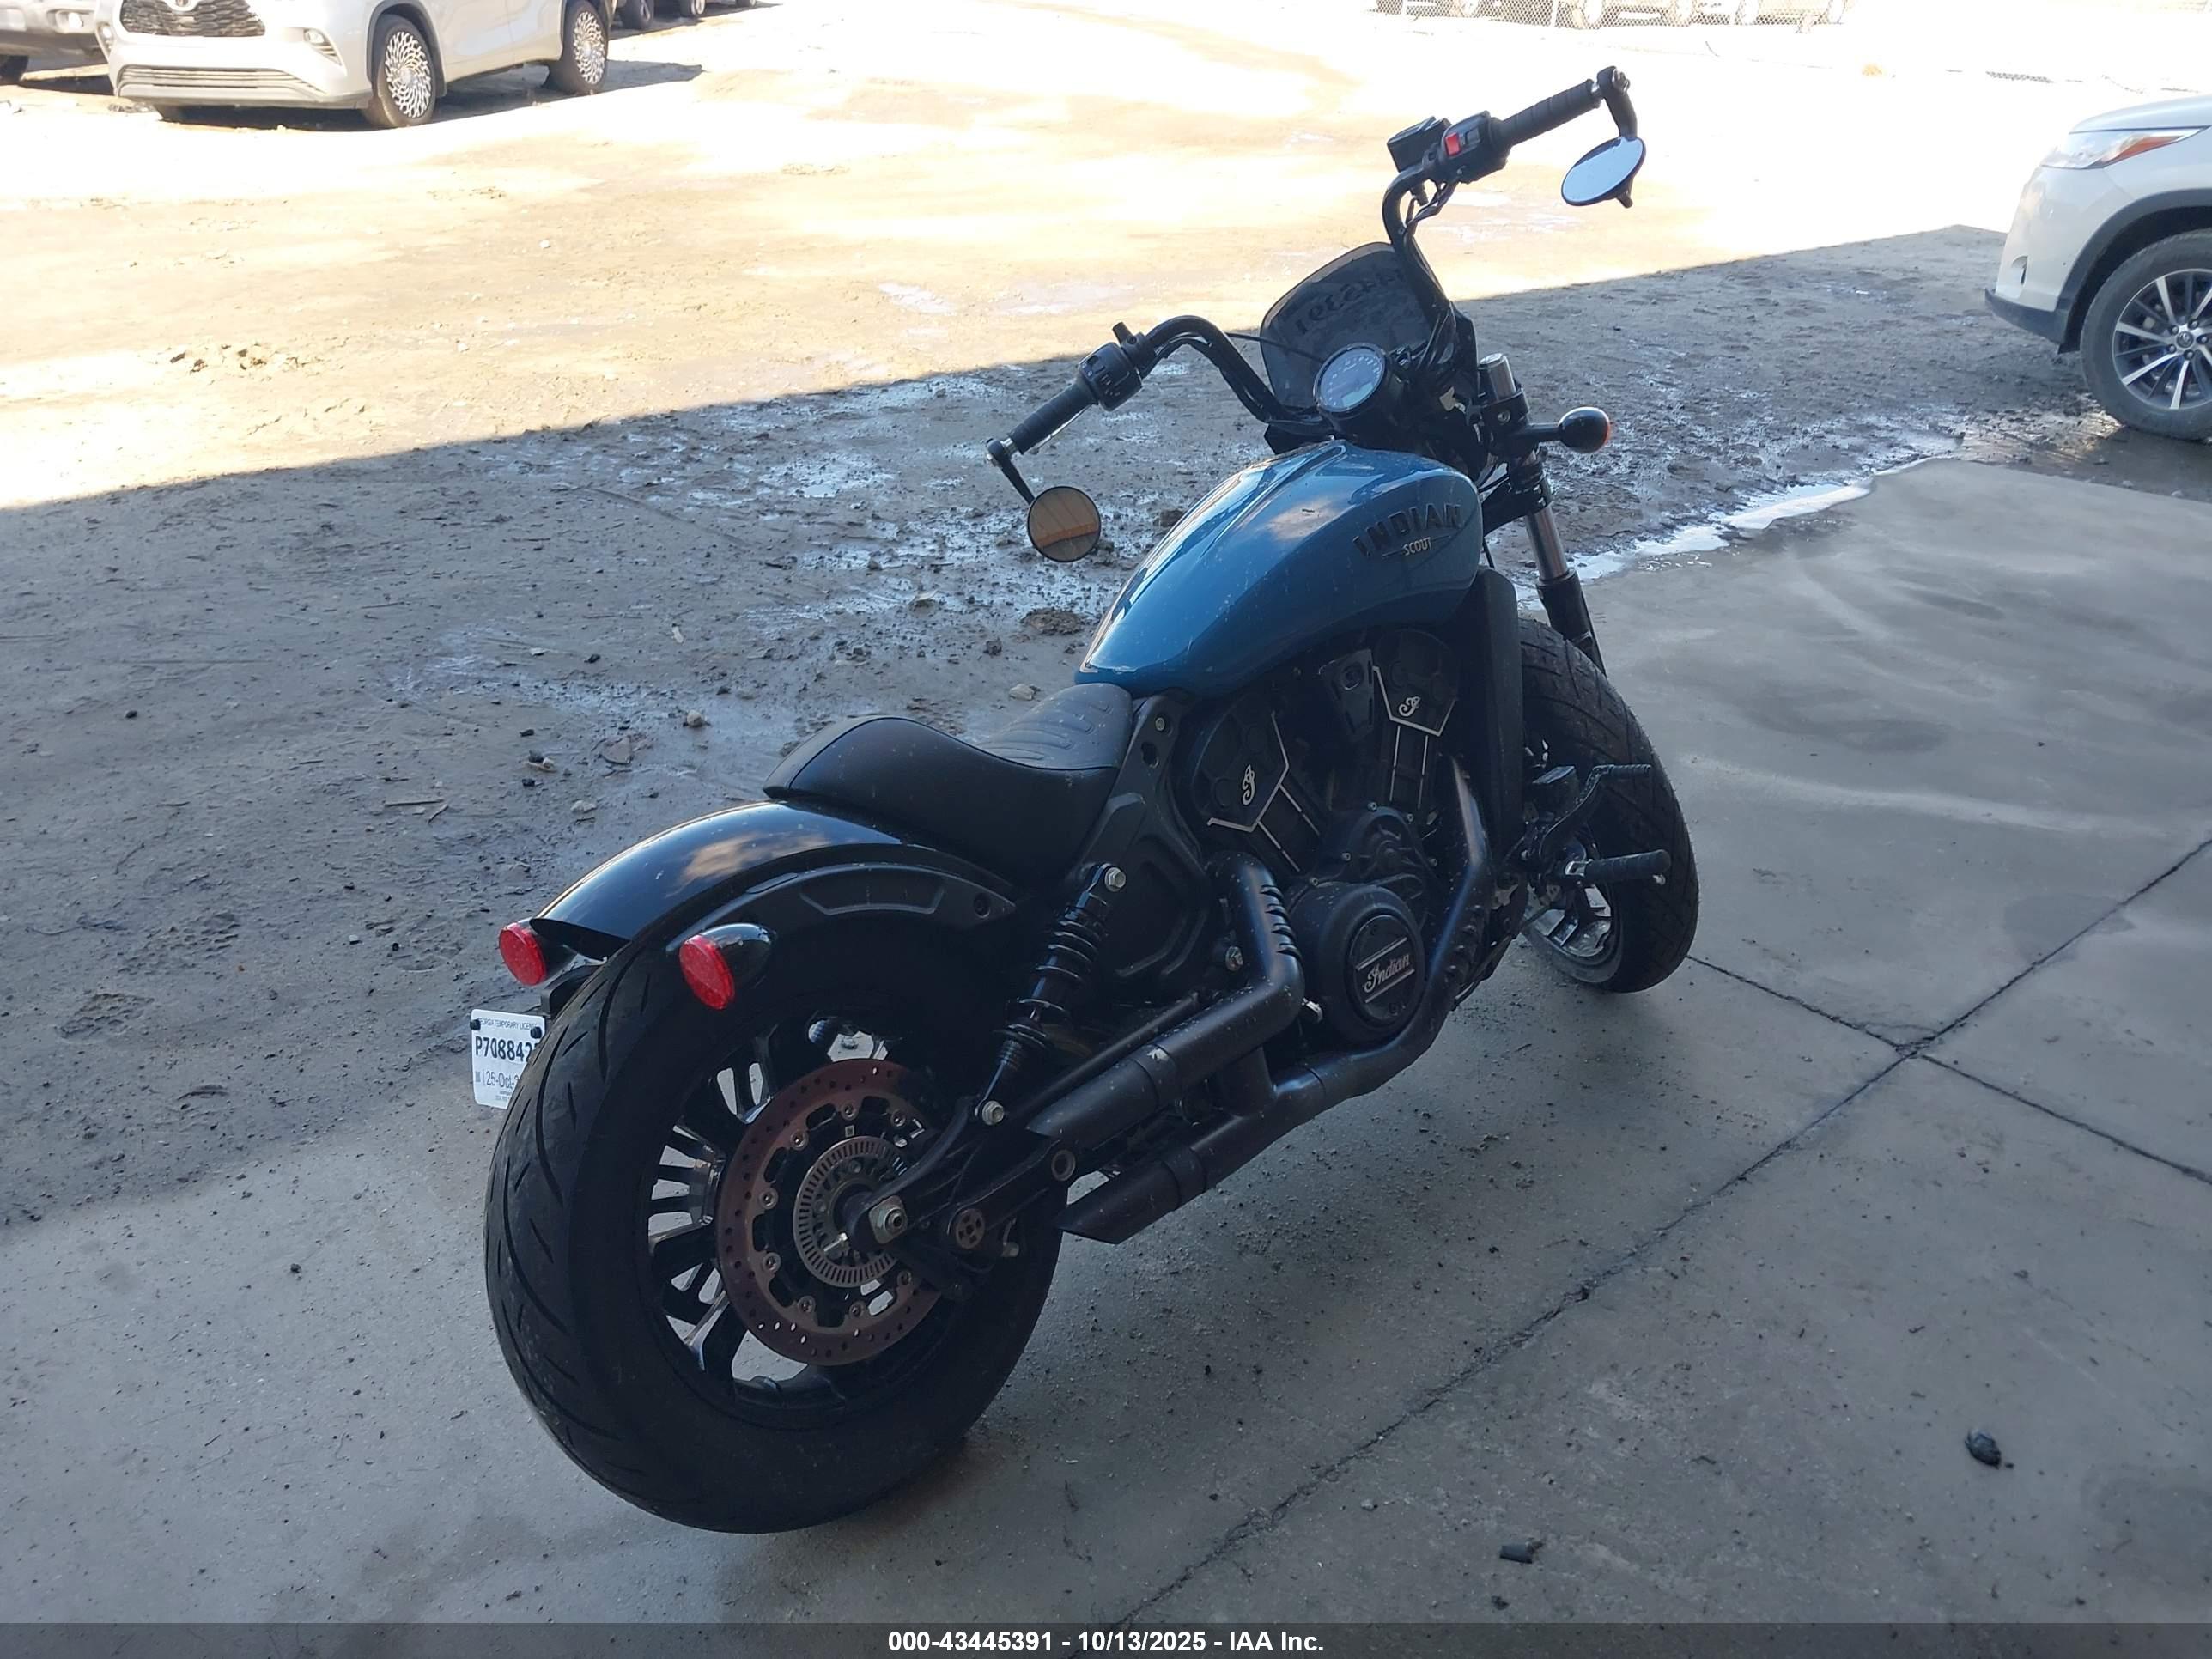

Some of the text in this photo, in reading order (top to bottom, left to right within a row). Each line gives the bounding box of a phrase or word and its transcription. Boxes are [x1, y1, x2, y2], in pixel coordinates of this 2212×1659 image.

[1352, 502, 1462, 557] INDIAN
[1402, 537, 1431, 556] SCOUT
[1364, 953, 1411, 994] Indian
[475, 1036, 540, 1062] P708842
